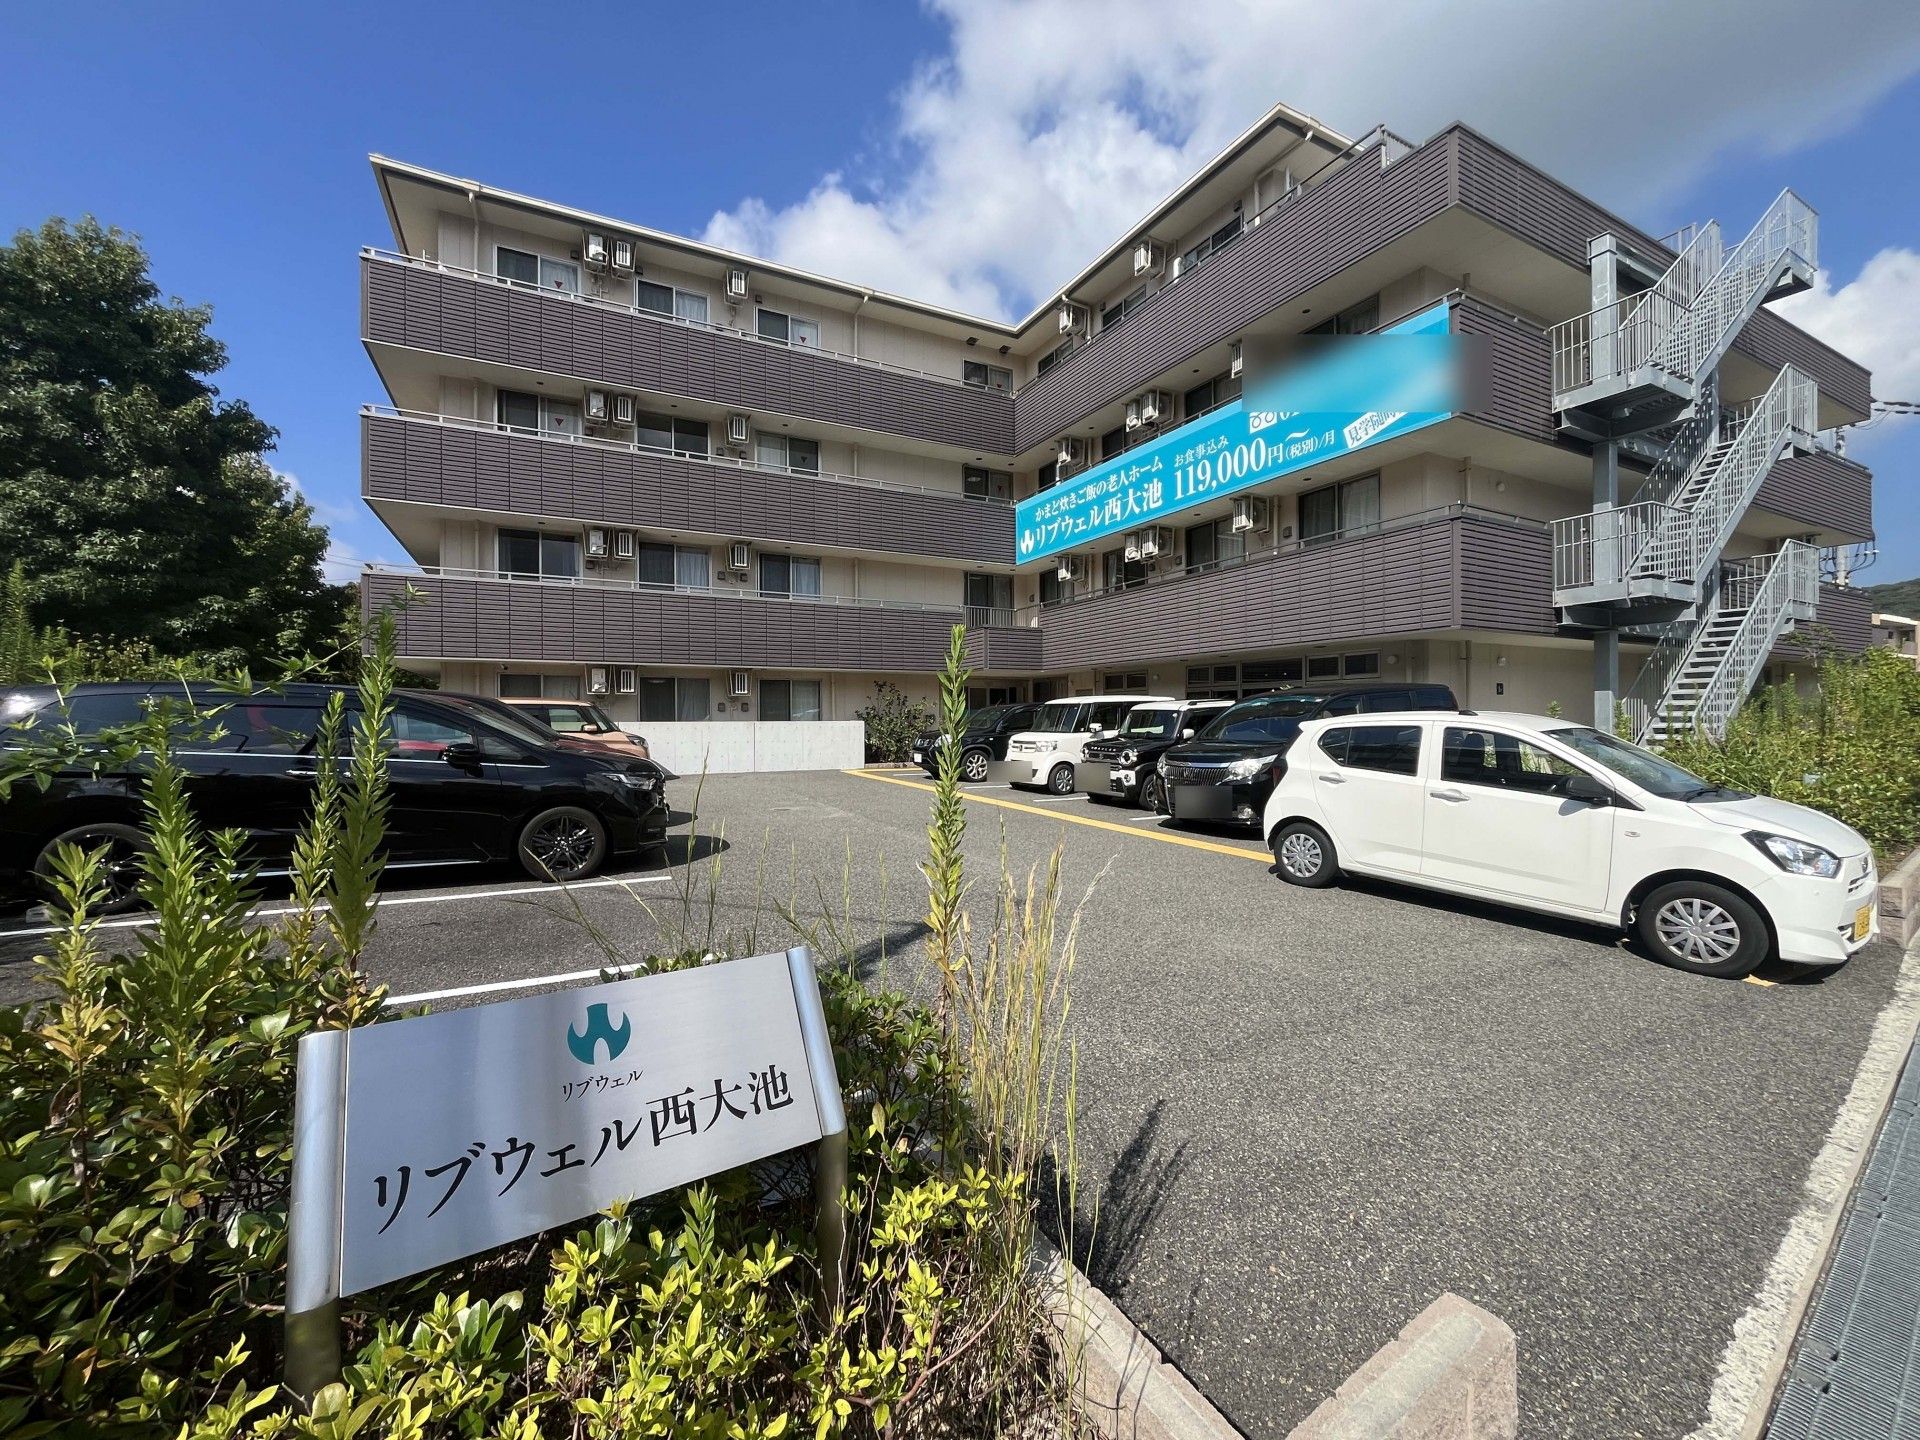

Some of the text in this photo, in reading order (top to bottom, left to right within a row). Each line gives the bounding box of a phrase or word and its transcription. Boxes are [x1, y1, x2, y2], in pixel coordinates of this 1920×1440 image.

[1174, 435, 1229, 468] お食事込み
[1035, 455, 1163, 522] かまど炊きご飯の老人ホーム
[1036, 478, 1163, 549] リブウェル西大池
[561, 1069, 644, 1103] リブウェル
[373, 1064, 795, 1235] リブウェル西大池
